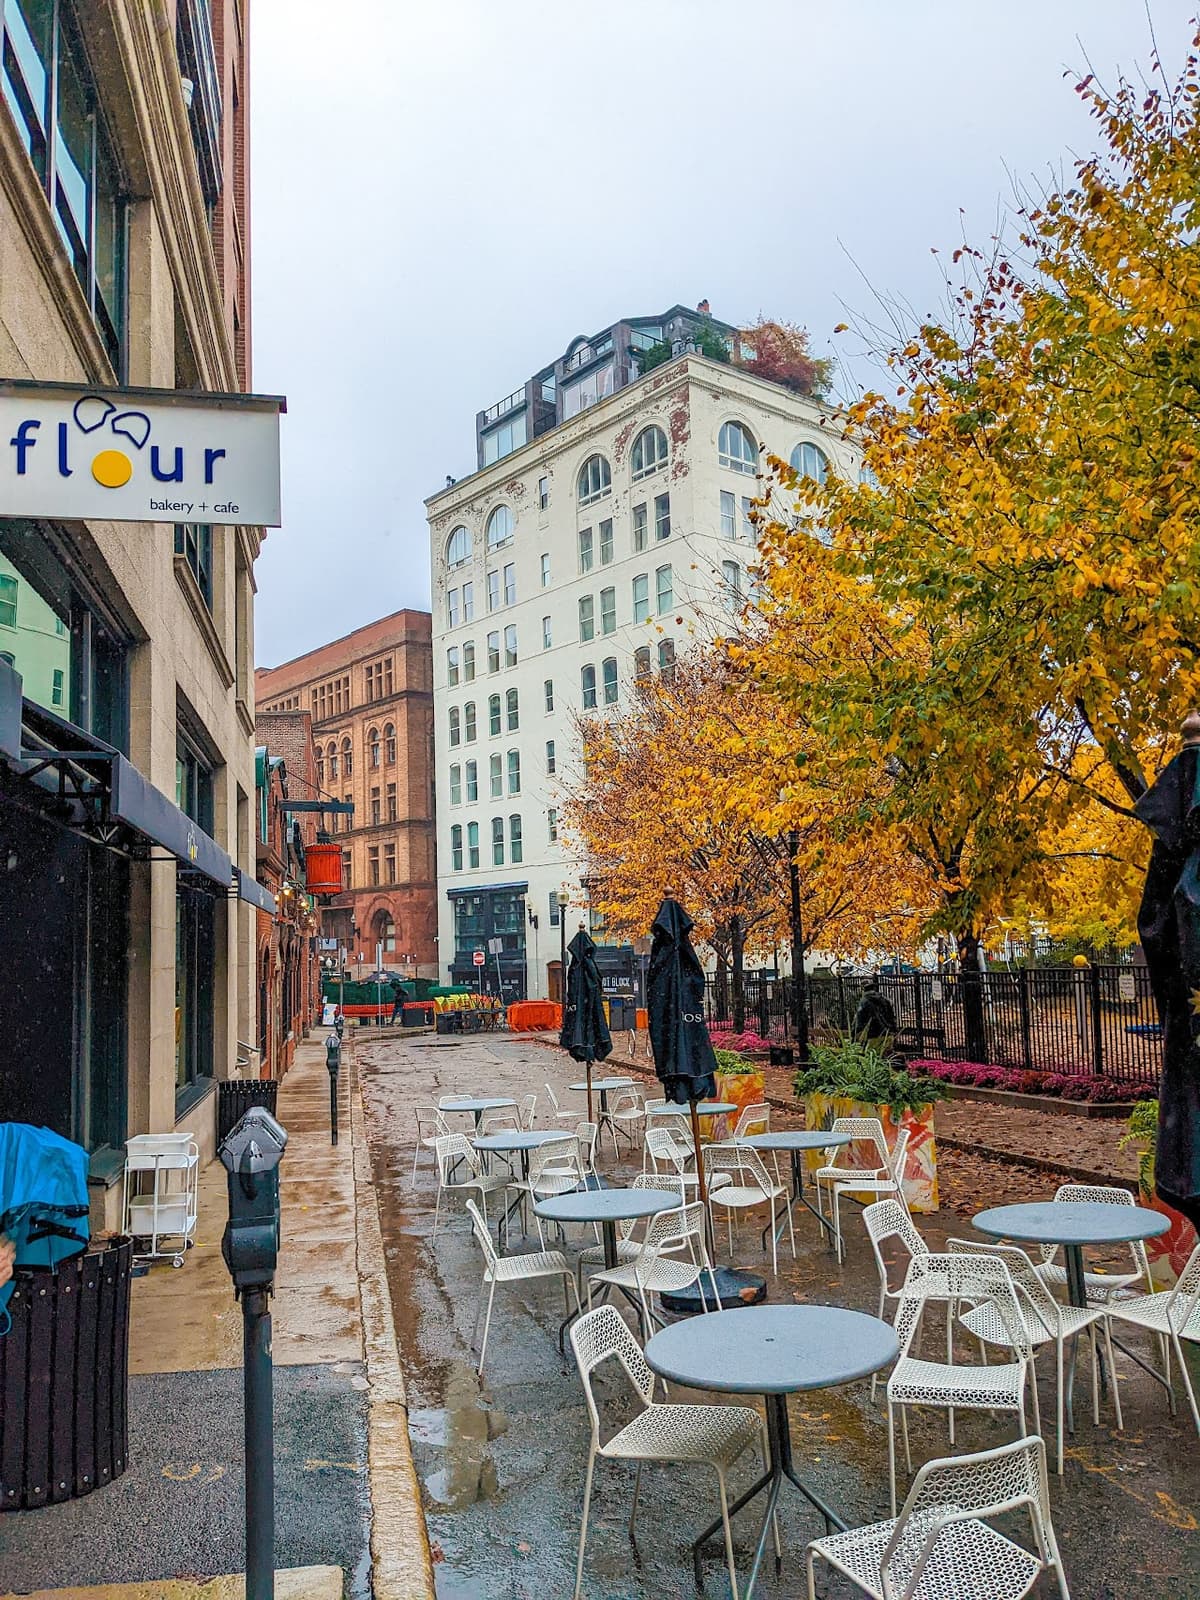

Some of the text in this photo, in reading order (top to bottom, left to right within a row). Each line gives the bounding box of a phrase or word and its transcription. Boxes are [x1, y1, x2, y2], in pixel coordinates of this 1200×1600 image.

[10, 419, 227, 488] flour
[150, 498, 194, 515] bakery
[213, 501, 240, 513] cafe
